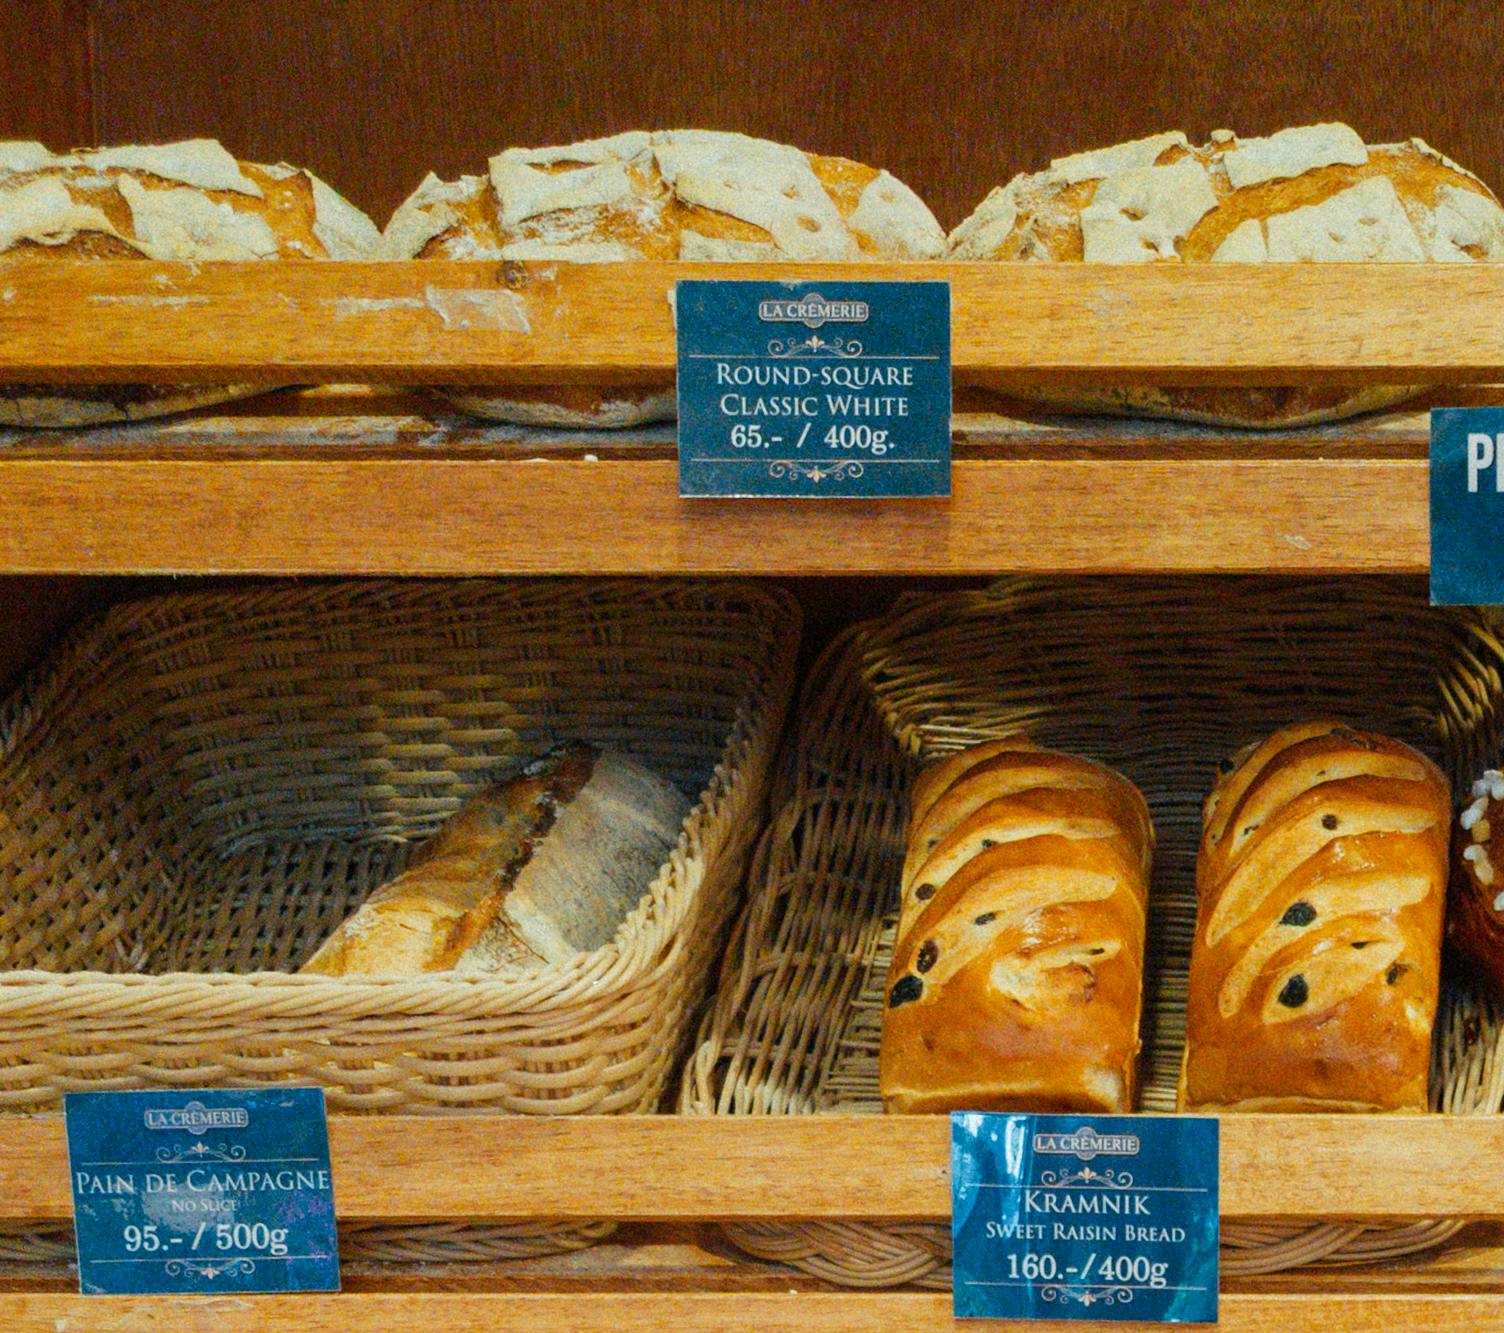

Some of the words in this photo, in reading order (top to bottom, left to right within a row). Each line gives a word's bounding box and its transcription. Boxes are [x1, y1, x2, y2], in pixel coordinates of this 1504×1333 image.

[763, 304, 783, 317] LA
[717, 363, 913, 389] ROUND-SQUARE
[720, 394, 818, 416] CLASSIC
[826, 394, 908, 416] WHITE
[731, 424, 783, 448] 65.-
[796, 423, 811, 447] /
[824, 424, 895, 455] 400g.
[148, 1112, 170, 1125] LA
[1036, 1136, 1057, 1150] LA
[76, 1171, 135, 1195] PAIN
[146, 1173, 177, 1193] DE
[187, 1169, 330, 1193] CAMPAGNE
[171, 1199, 196, 1213] NO
[1024, 1190, 1151, 1215] KRAMNIK
[123, 1225, 183, 1252] 95.-
[216, 1223, 289, 1256] 500g
[986, 1221, 1047, 1239] SWEET
[1053, 1223, 1117, 1241] RAISIN
[1125, 1225, 1186, 1243] BREAD
